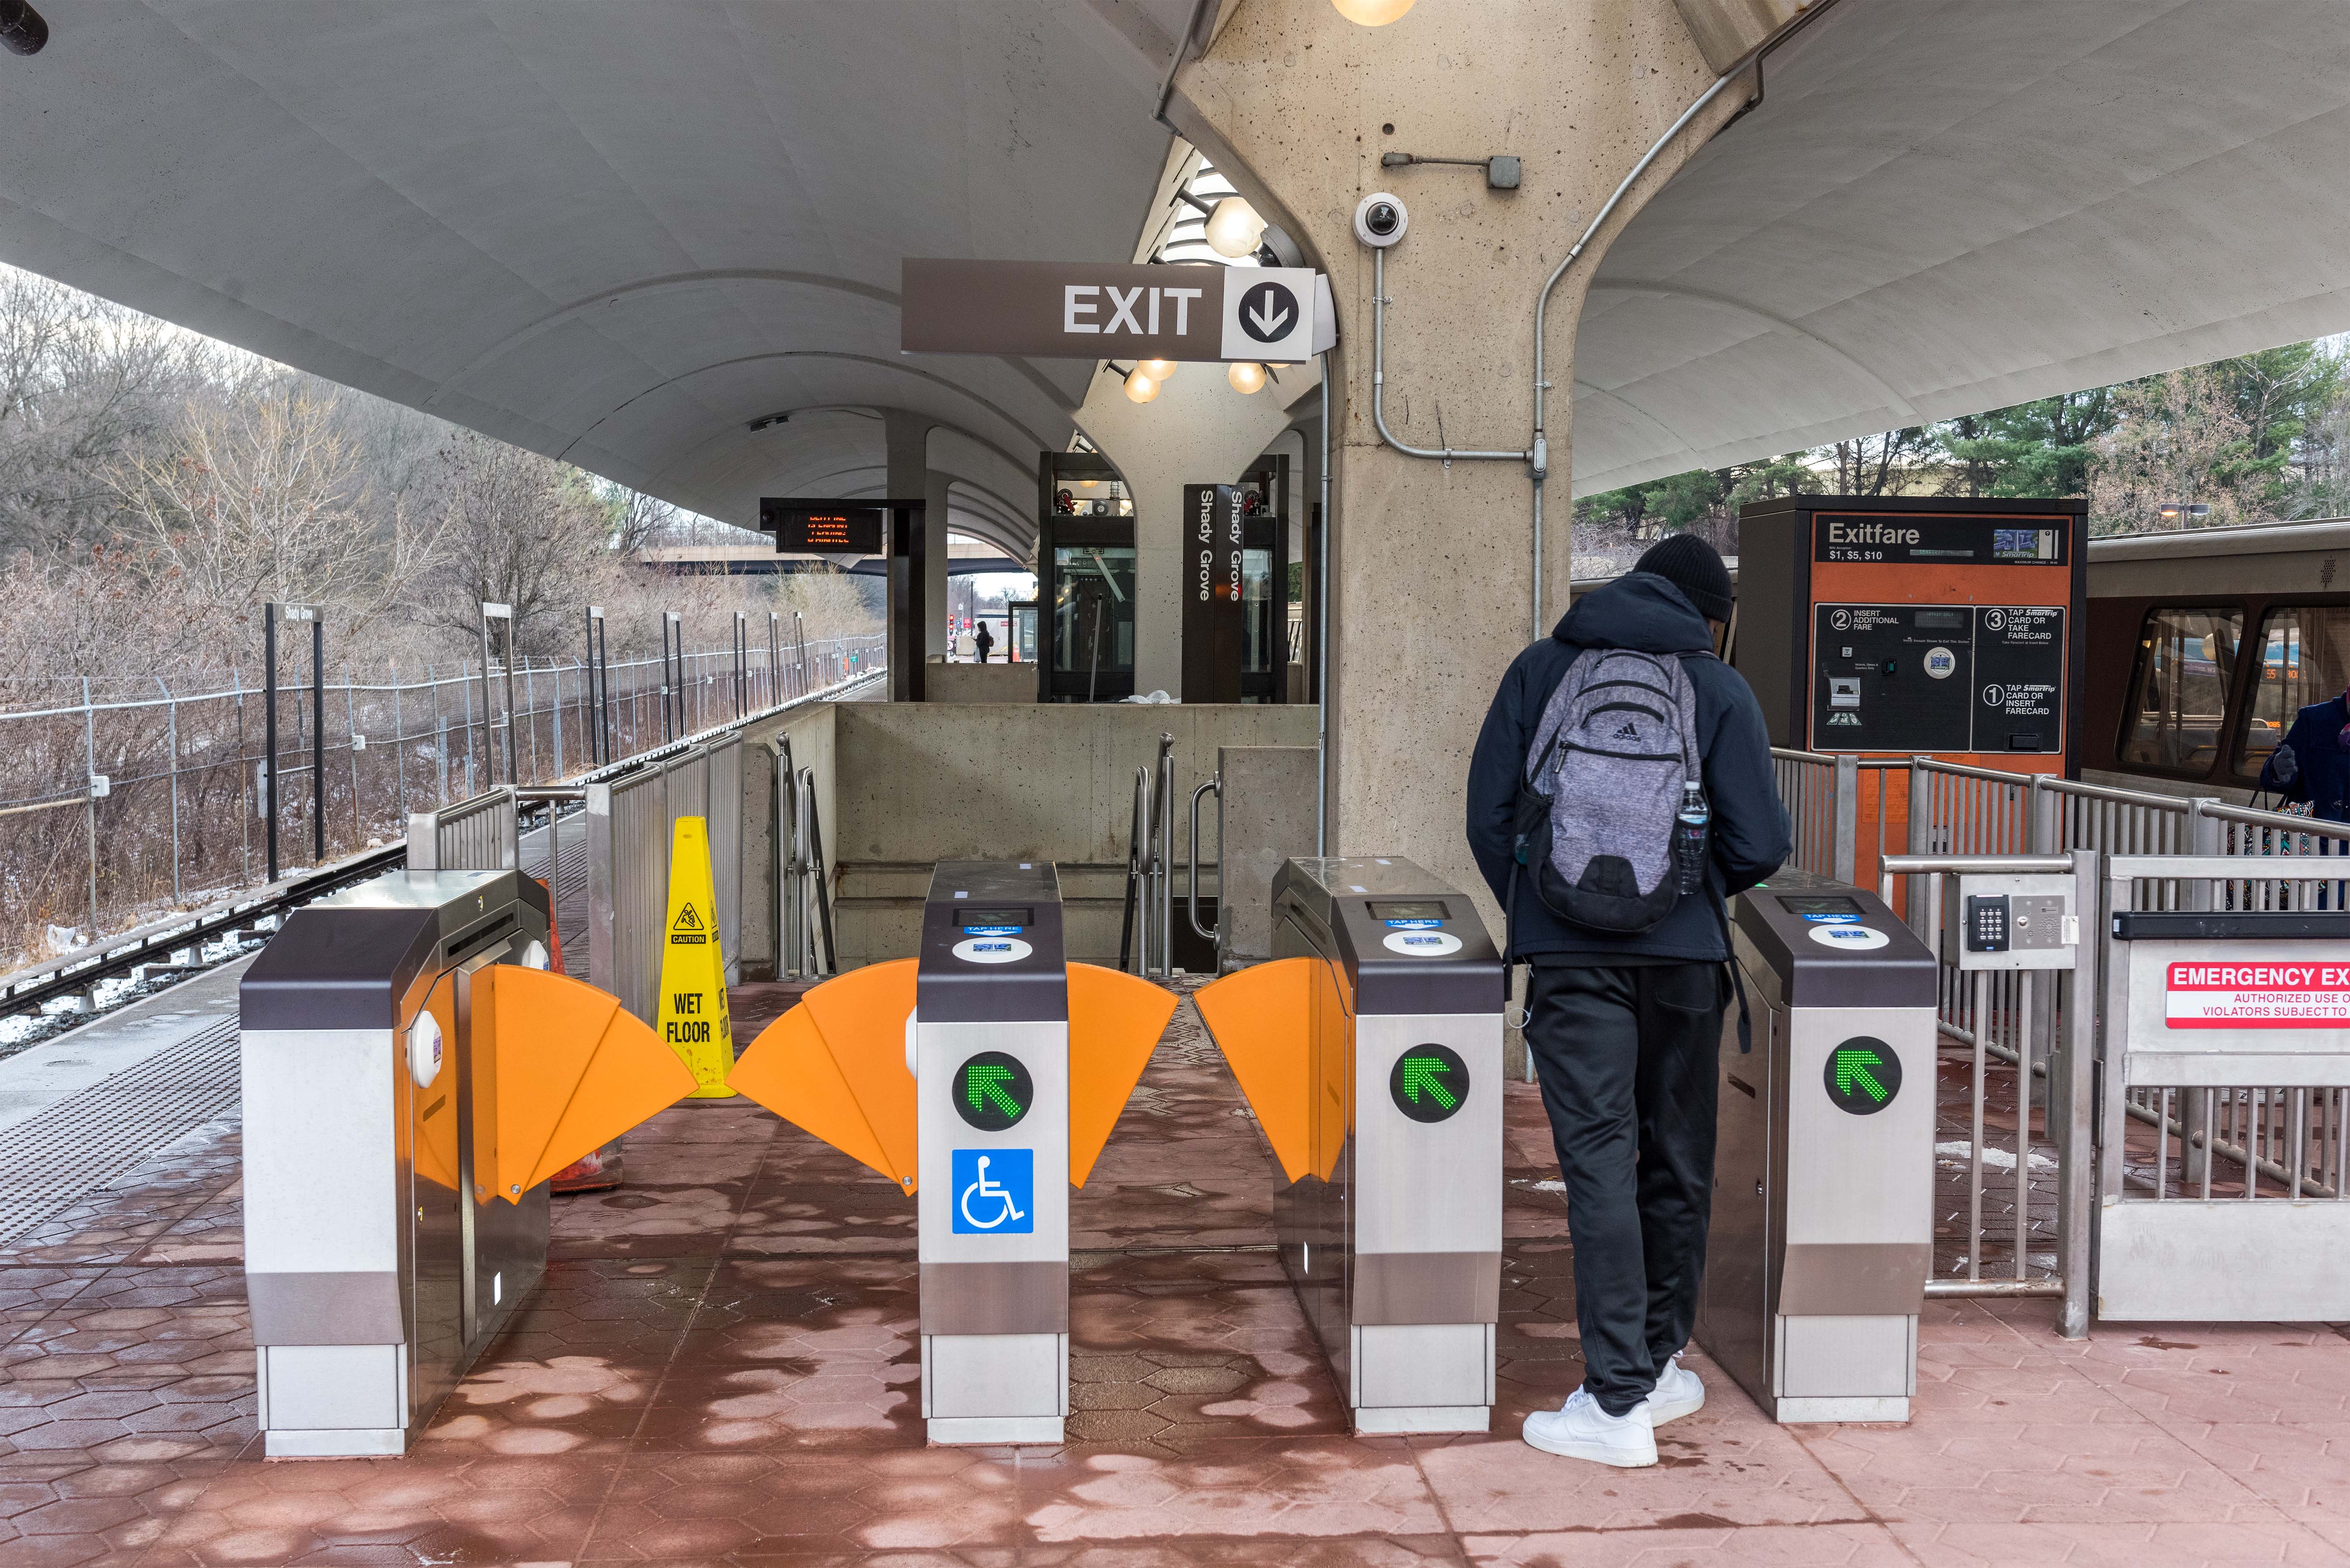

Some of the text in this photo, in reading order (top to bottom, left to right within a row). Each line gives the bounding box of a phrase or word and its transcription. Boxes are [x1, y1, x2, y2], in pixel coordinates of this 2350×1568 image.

[1064, 285, 1202, 335] EXIT
[1829, 523, 1920, 544] Exitfare
[1198, 490, 1213, 601] Shady Grove
[1229, 491, 1242, 602] Shady Grove
[1830, 550, 1882, 561] $1, $5, $10
[285, 605, 313, 622] Shady Grove
[2267, 669, 2276, 678] 55
[1613, 734, 1641, 742] adidas
[2174, 967, 2315, 986] EMERGENCY
[674, 993, 703, 1014] WET
[2234, 993, 2311, 1003] AUTHORIZED
[2315, 994, 2338, 1003] USE
[2203, 1007, 2347, 1016] VIOLATORS SUBJECT TO
[667, 1021, 710, 1043] FLOOR
[720, 1014, 730, 1041] FLOOR
